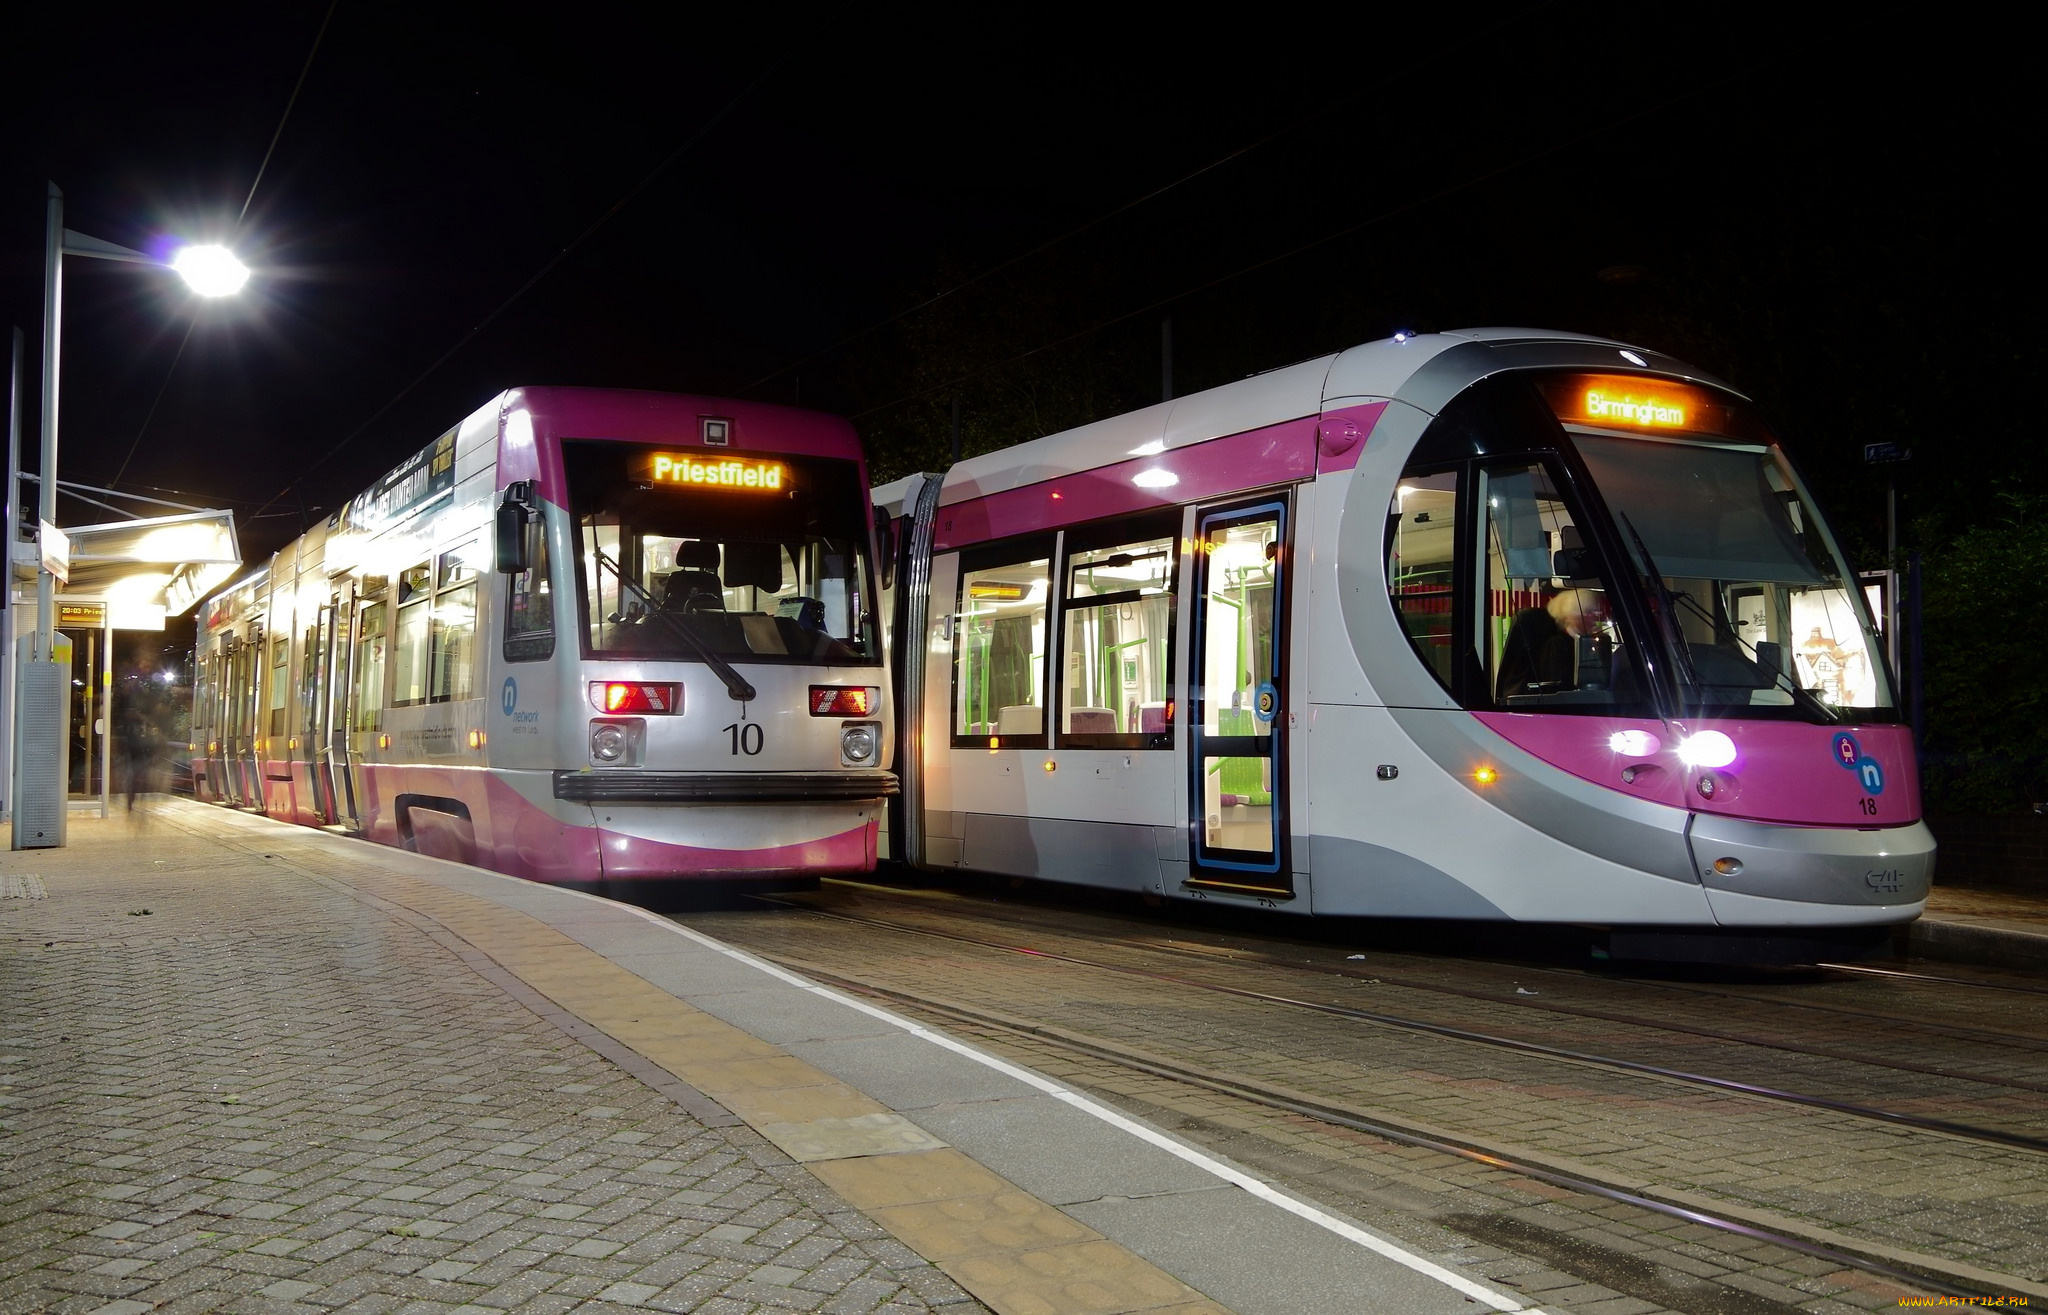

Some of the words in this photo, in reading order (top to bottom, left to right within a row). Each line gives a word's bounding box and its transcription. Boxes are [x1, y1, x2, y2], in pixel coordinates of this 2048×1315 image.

[1586, 391, 1685, 426] Birmingham
[653, 455, 783, 489] Priestfield
[945, 520, 953, 532] 18
[513, 709, 540, 723] network
[722, 722, 764, 755] 10
[1859, 797, 1877, 816] 18
